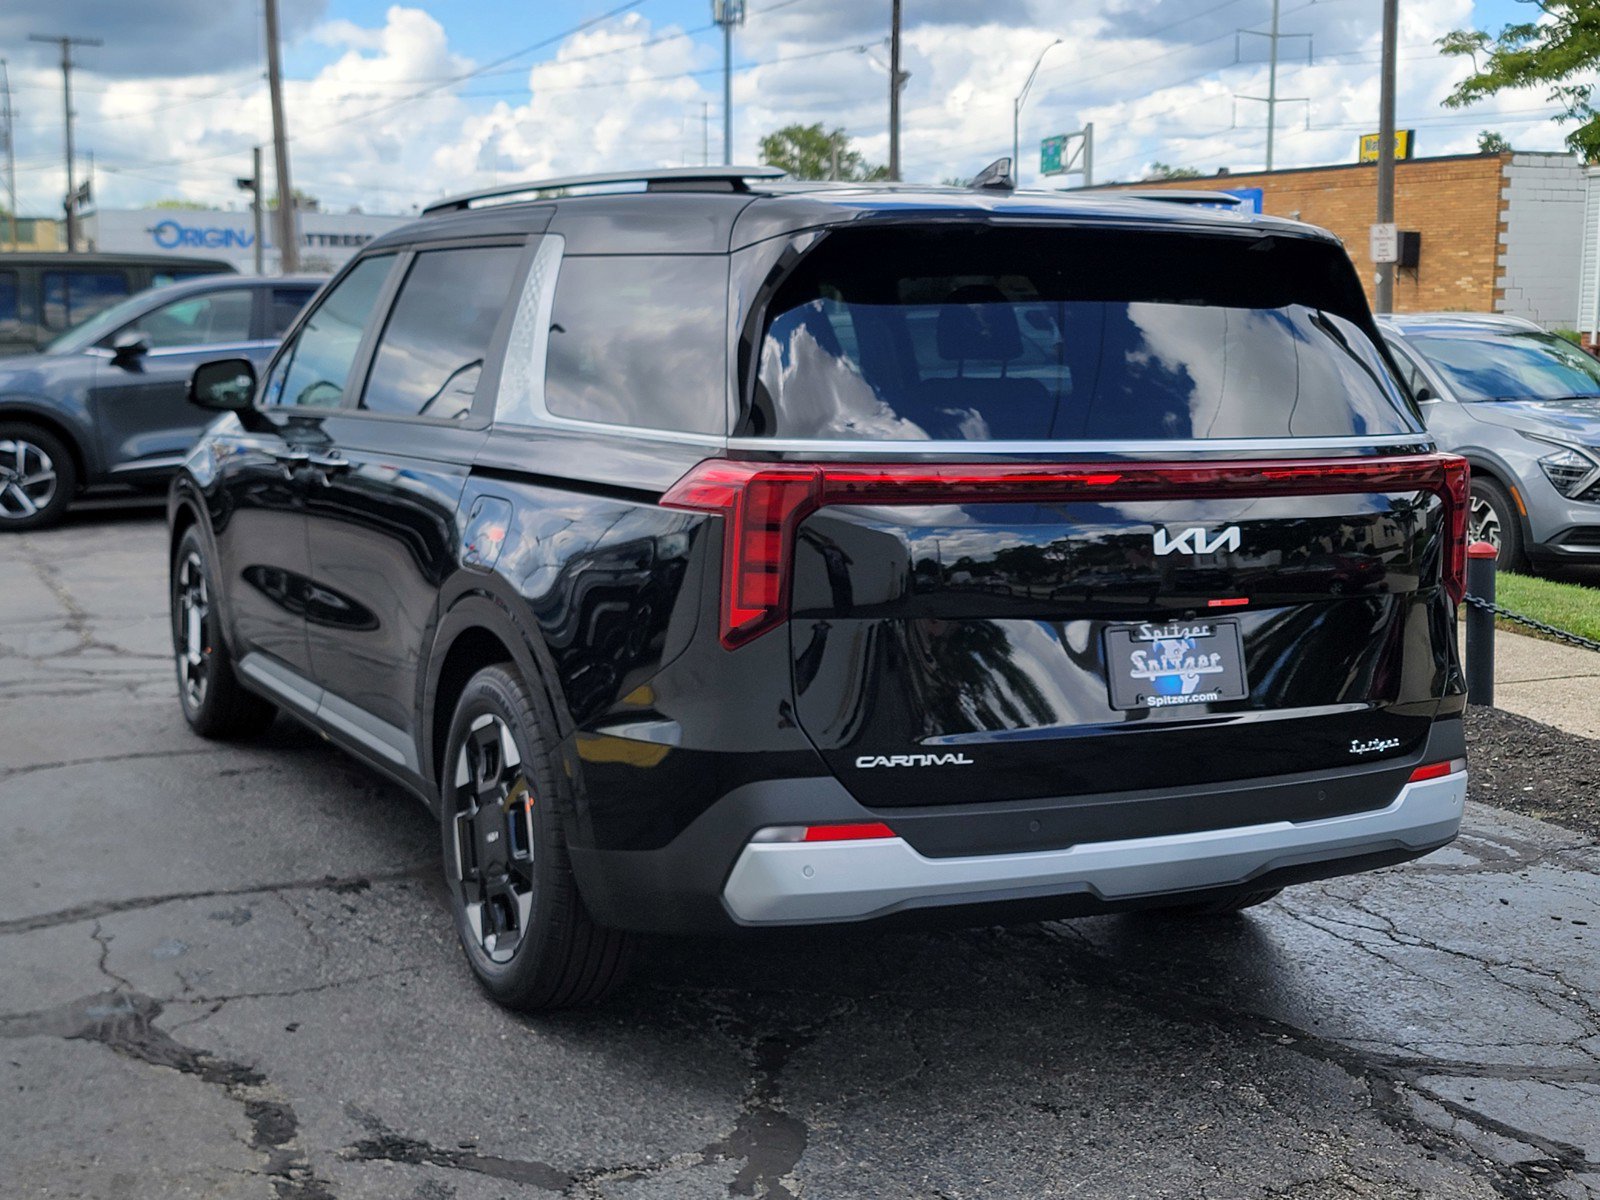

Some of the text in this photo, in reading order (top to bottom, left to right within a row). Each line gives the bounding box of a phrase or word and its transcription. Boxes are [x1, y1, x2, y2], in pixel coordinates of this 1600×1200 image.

[1153, 526, 1241, 555] KIA
[1139, 624, 1211, 641] Spitzer
[1130, 650, 1223, 681] Spitzer
[1147, 692, 1218, 707] Spitzer.com
[855, 753, 974, 768] CARNIVAL
